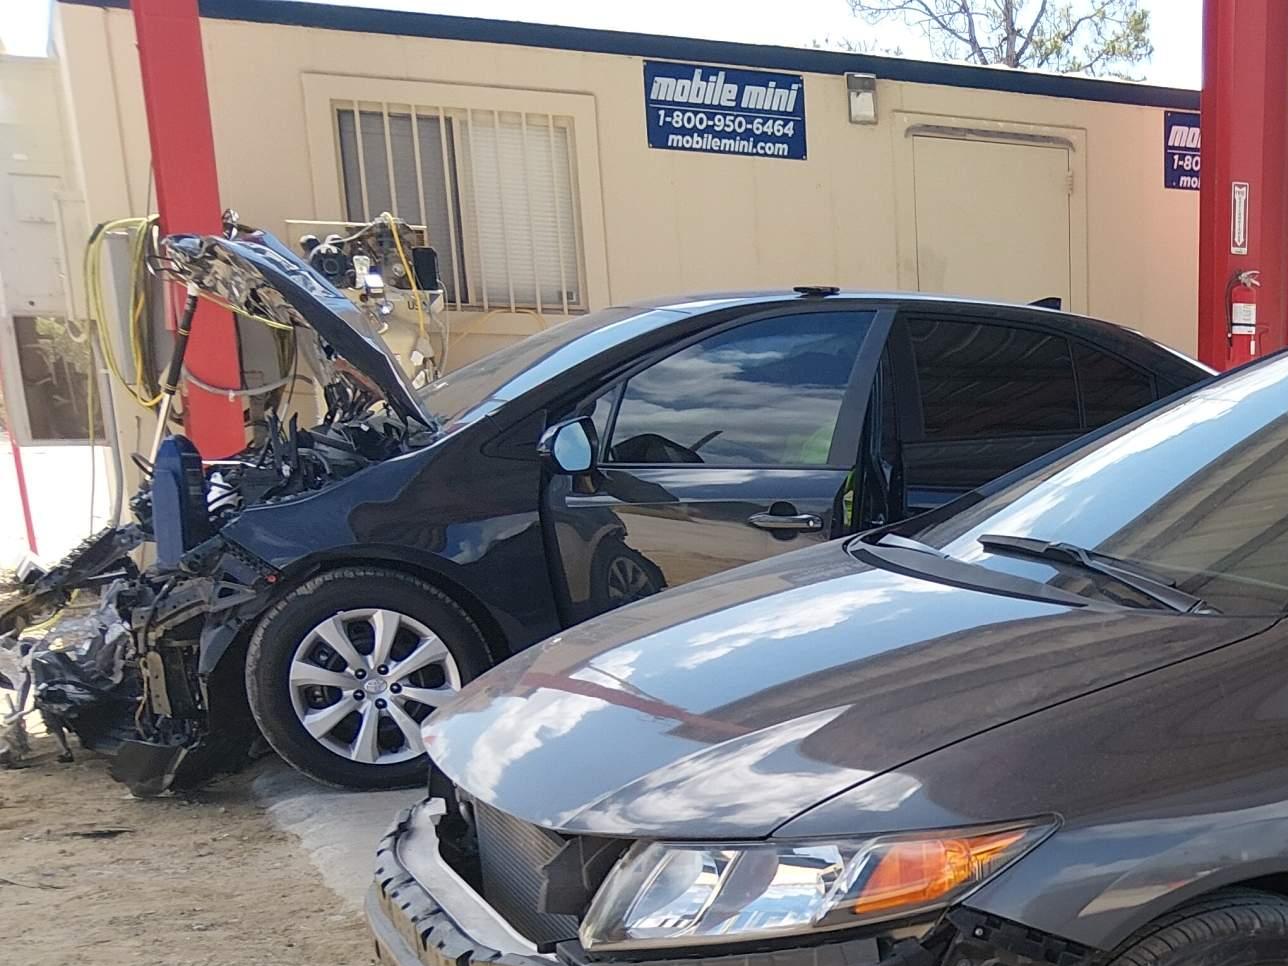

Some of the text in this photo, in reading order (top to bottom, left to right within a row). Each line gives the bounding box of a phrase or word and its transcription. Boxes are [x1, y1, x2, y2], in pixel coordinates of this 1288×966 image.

[650, 69, 799, 112] mobile mini
[658, 110, 795, 137] 1-800-950-6464
[667, 133, 788, 156] mobilemini.com
[1168, 125, 1200, 148] mo
[1179, 175, 1200, 188] mo
